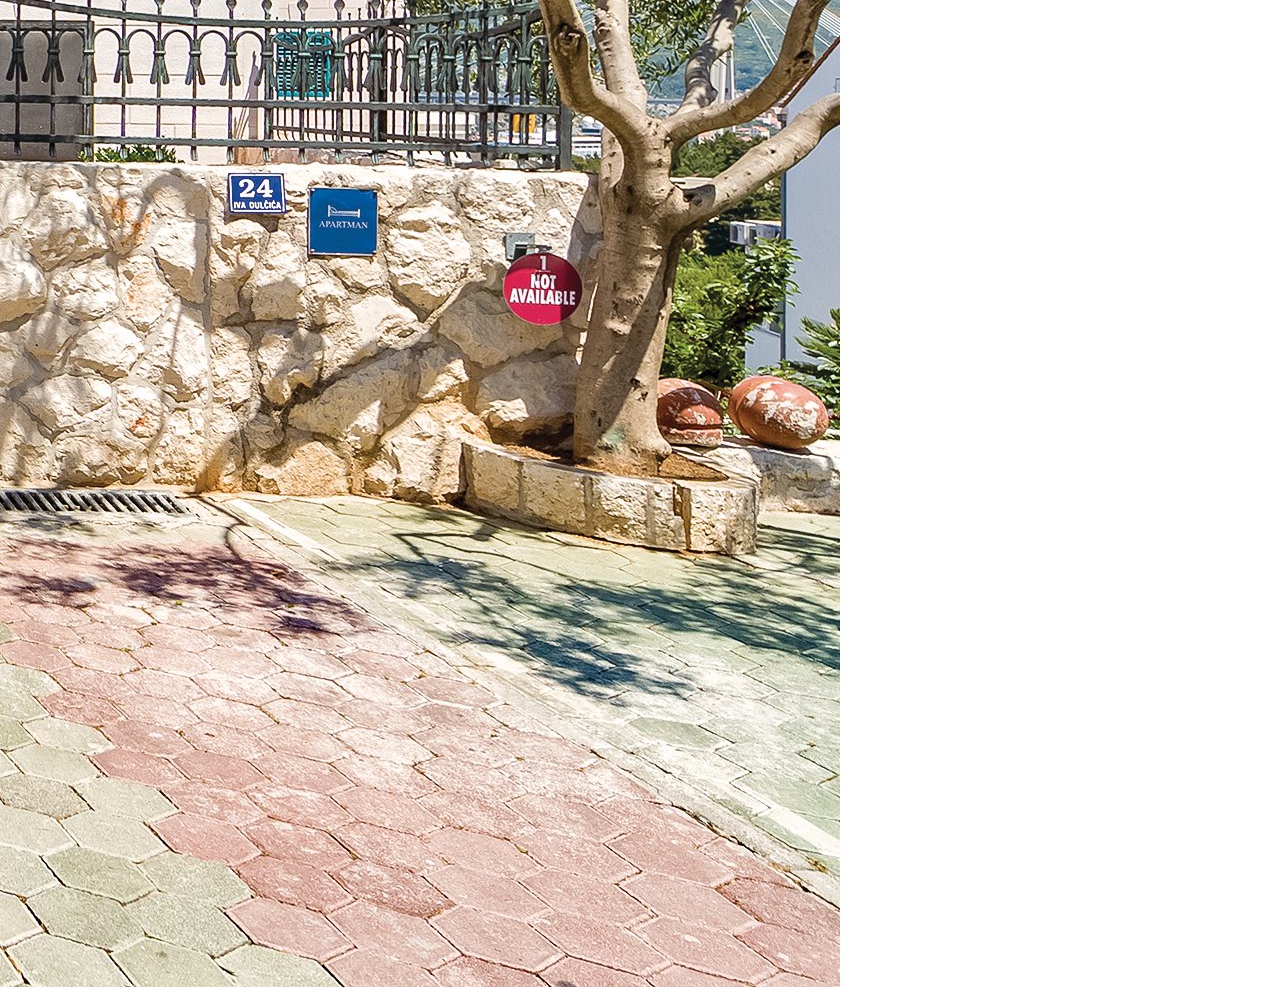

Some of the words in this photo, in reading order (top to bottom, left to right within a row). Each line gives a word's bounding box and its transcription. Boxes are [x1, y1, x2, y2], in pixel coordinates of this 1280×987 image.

[238, 178, 274, 198] 24
[233, 201, 247, 209] IVA
[318, 220, 368, 229] APARTMAN
[540, 255, 547, 270] 1
[530, 273, 557, 290] NOT
[509, 287, 576, 306] AVAILABLE
